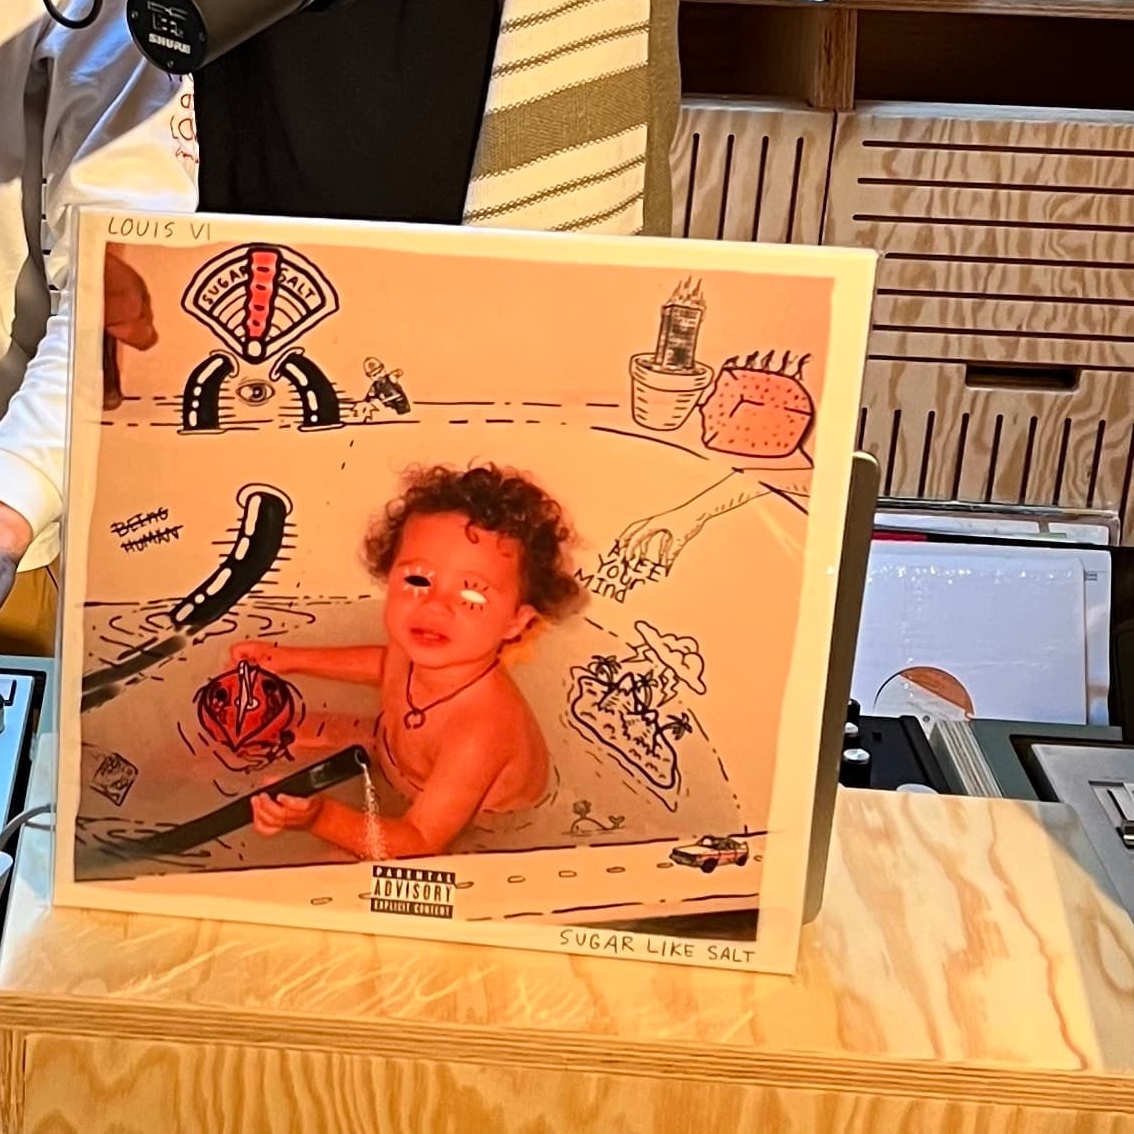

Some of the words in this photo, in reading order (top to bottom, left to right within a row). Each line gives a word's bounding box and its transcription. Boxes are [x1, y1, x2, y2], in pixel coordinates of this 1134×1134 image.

[108, 217, 175, 239] LOUIS
[190, 223, 211, 241] VI
[278, 267, 316, 300] SALT
[376, 867, 452, 883] PARENTAL
[374, 878, 452, 903] ADVISORY
[374, 899, 411, 913] EXPLICIT
[413, 903, 451, 917] CONTENT
[560, 929, 635, 954] SUGAR
[647, 938, 696, 958] LIKE
[707, 945, 757, 964] SALT
